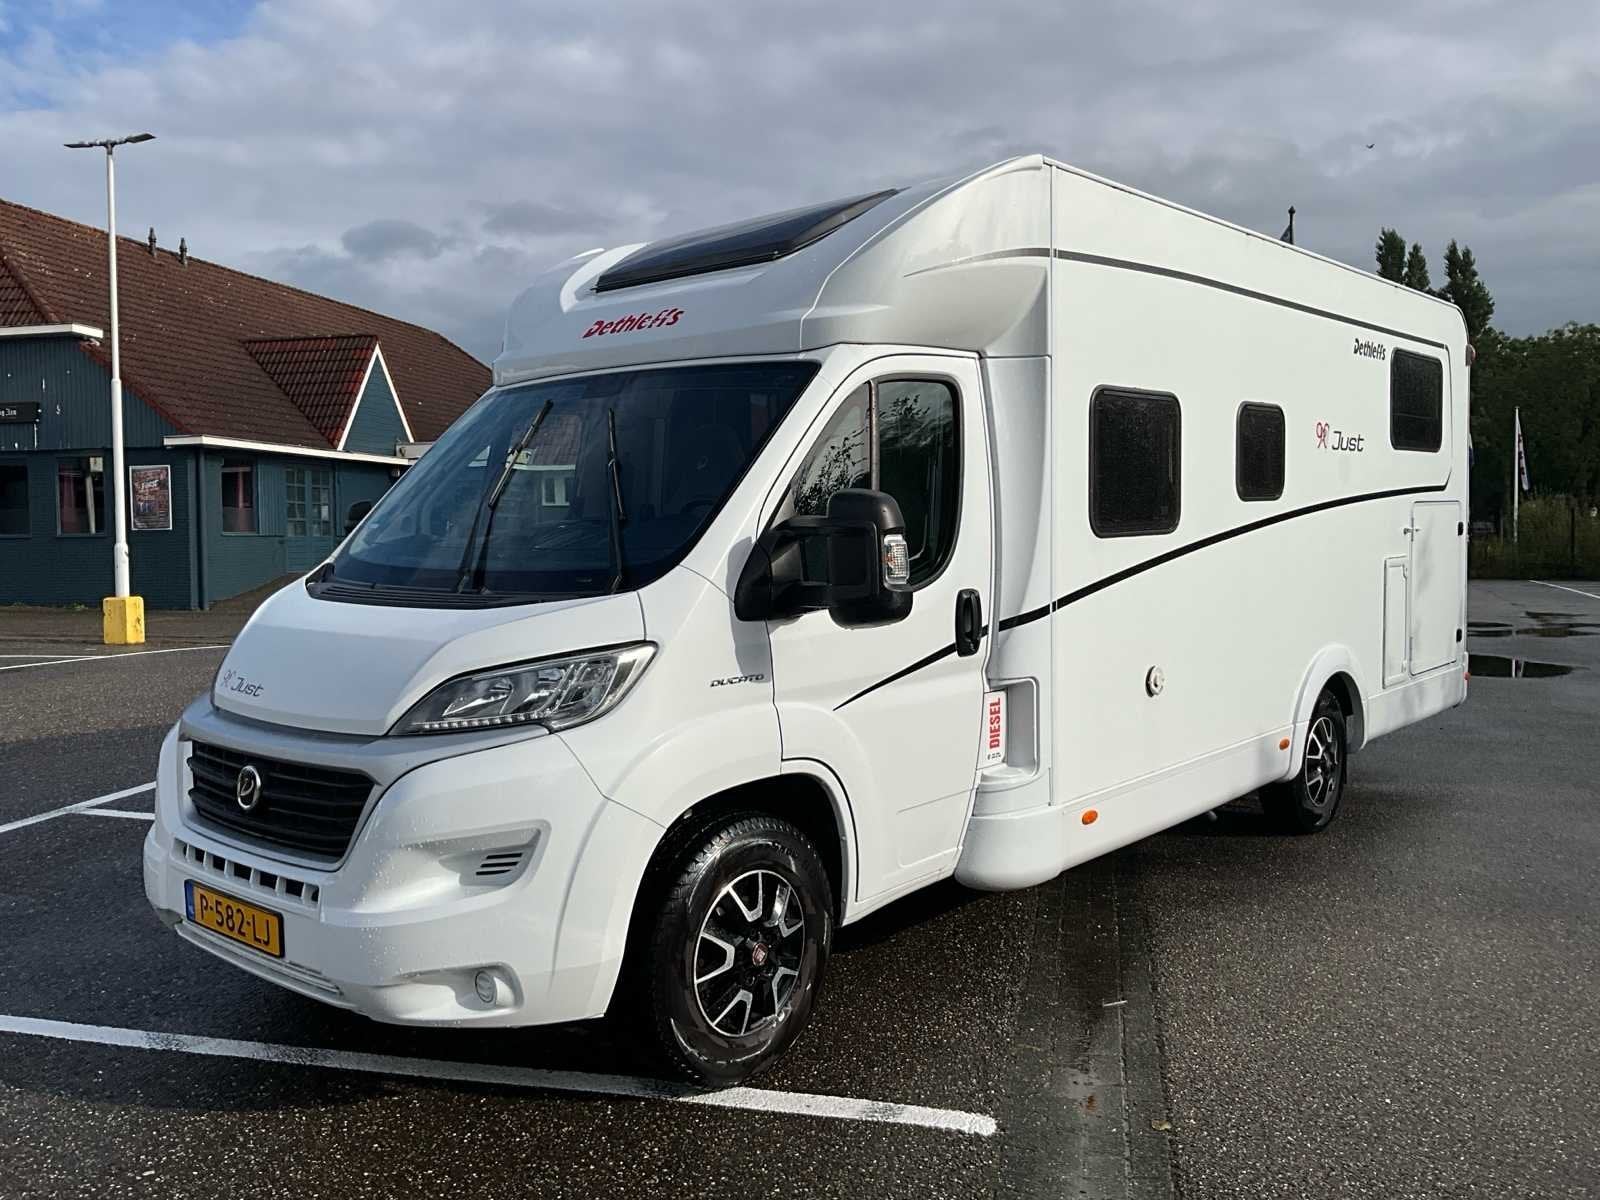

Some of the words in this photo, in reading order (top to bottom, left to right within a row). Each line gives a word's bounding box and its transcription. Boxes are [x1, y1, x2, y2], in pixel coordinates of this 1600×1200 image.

[583, 308, 684, 338] Dethleffs
[1353, 338, 1386, 361] Dethleffs
[1331, 430, 1364, 452] Just
[231, 677, 264, 697] Just
[710, 674, 764, 687] DUCATO
[986, 696, 1001, 750] DIESEL
[200, 893, 270, 947] P-582-LJ
